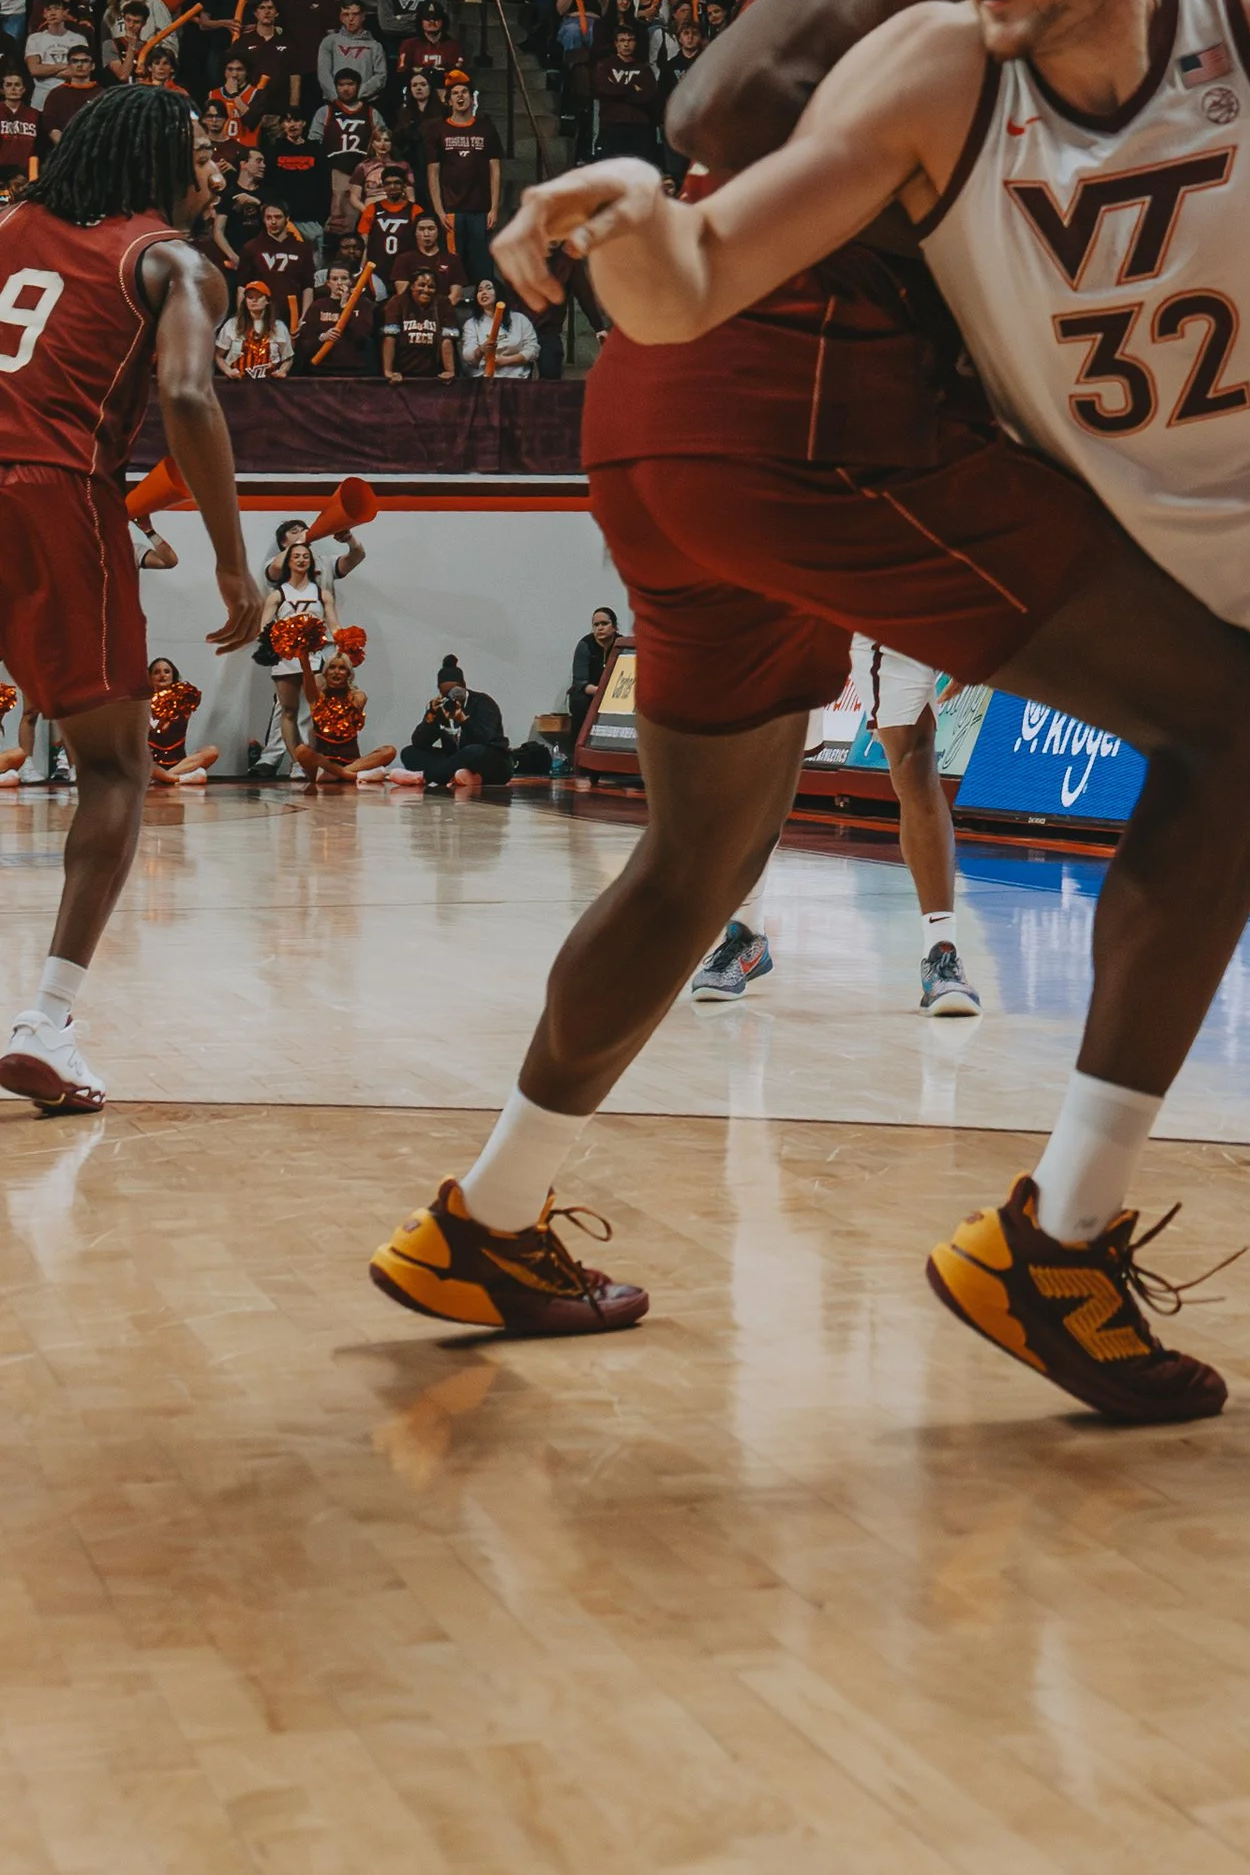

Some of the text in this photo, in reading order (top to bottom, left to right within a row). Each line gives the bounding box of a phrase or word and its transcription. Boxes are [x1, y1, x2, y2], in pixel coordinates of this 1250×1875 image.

[337, 44, 369, 61] VT
[335, 118, 366, 132] VT
[340, 133, 361, 151] 12
[376, 218, 409, 234] VT
[1004, 145, 1239, 291] VT
[386, 236, 398, 255] 0
[286, 600, 317, 614] VT
